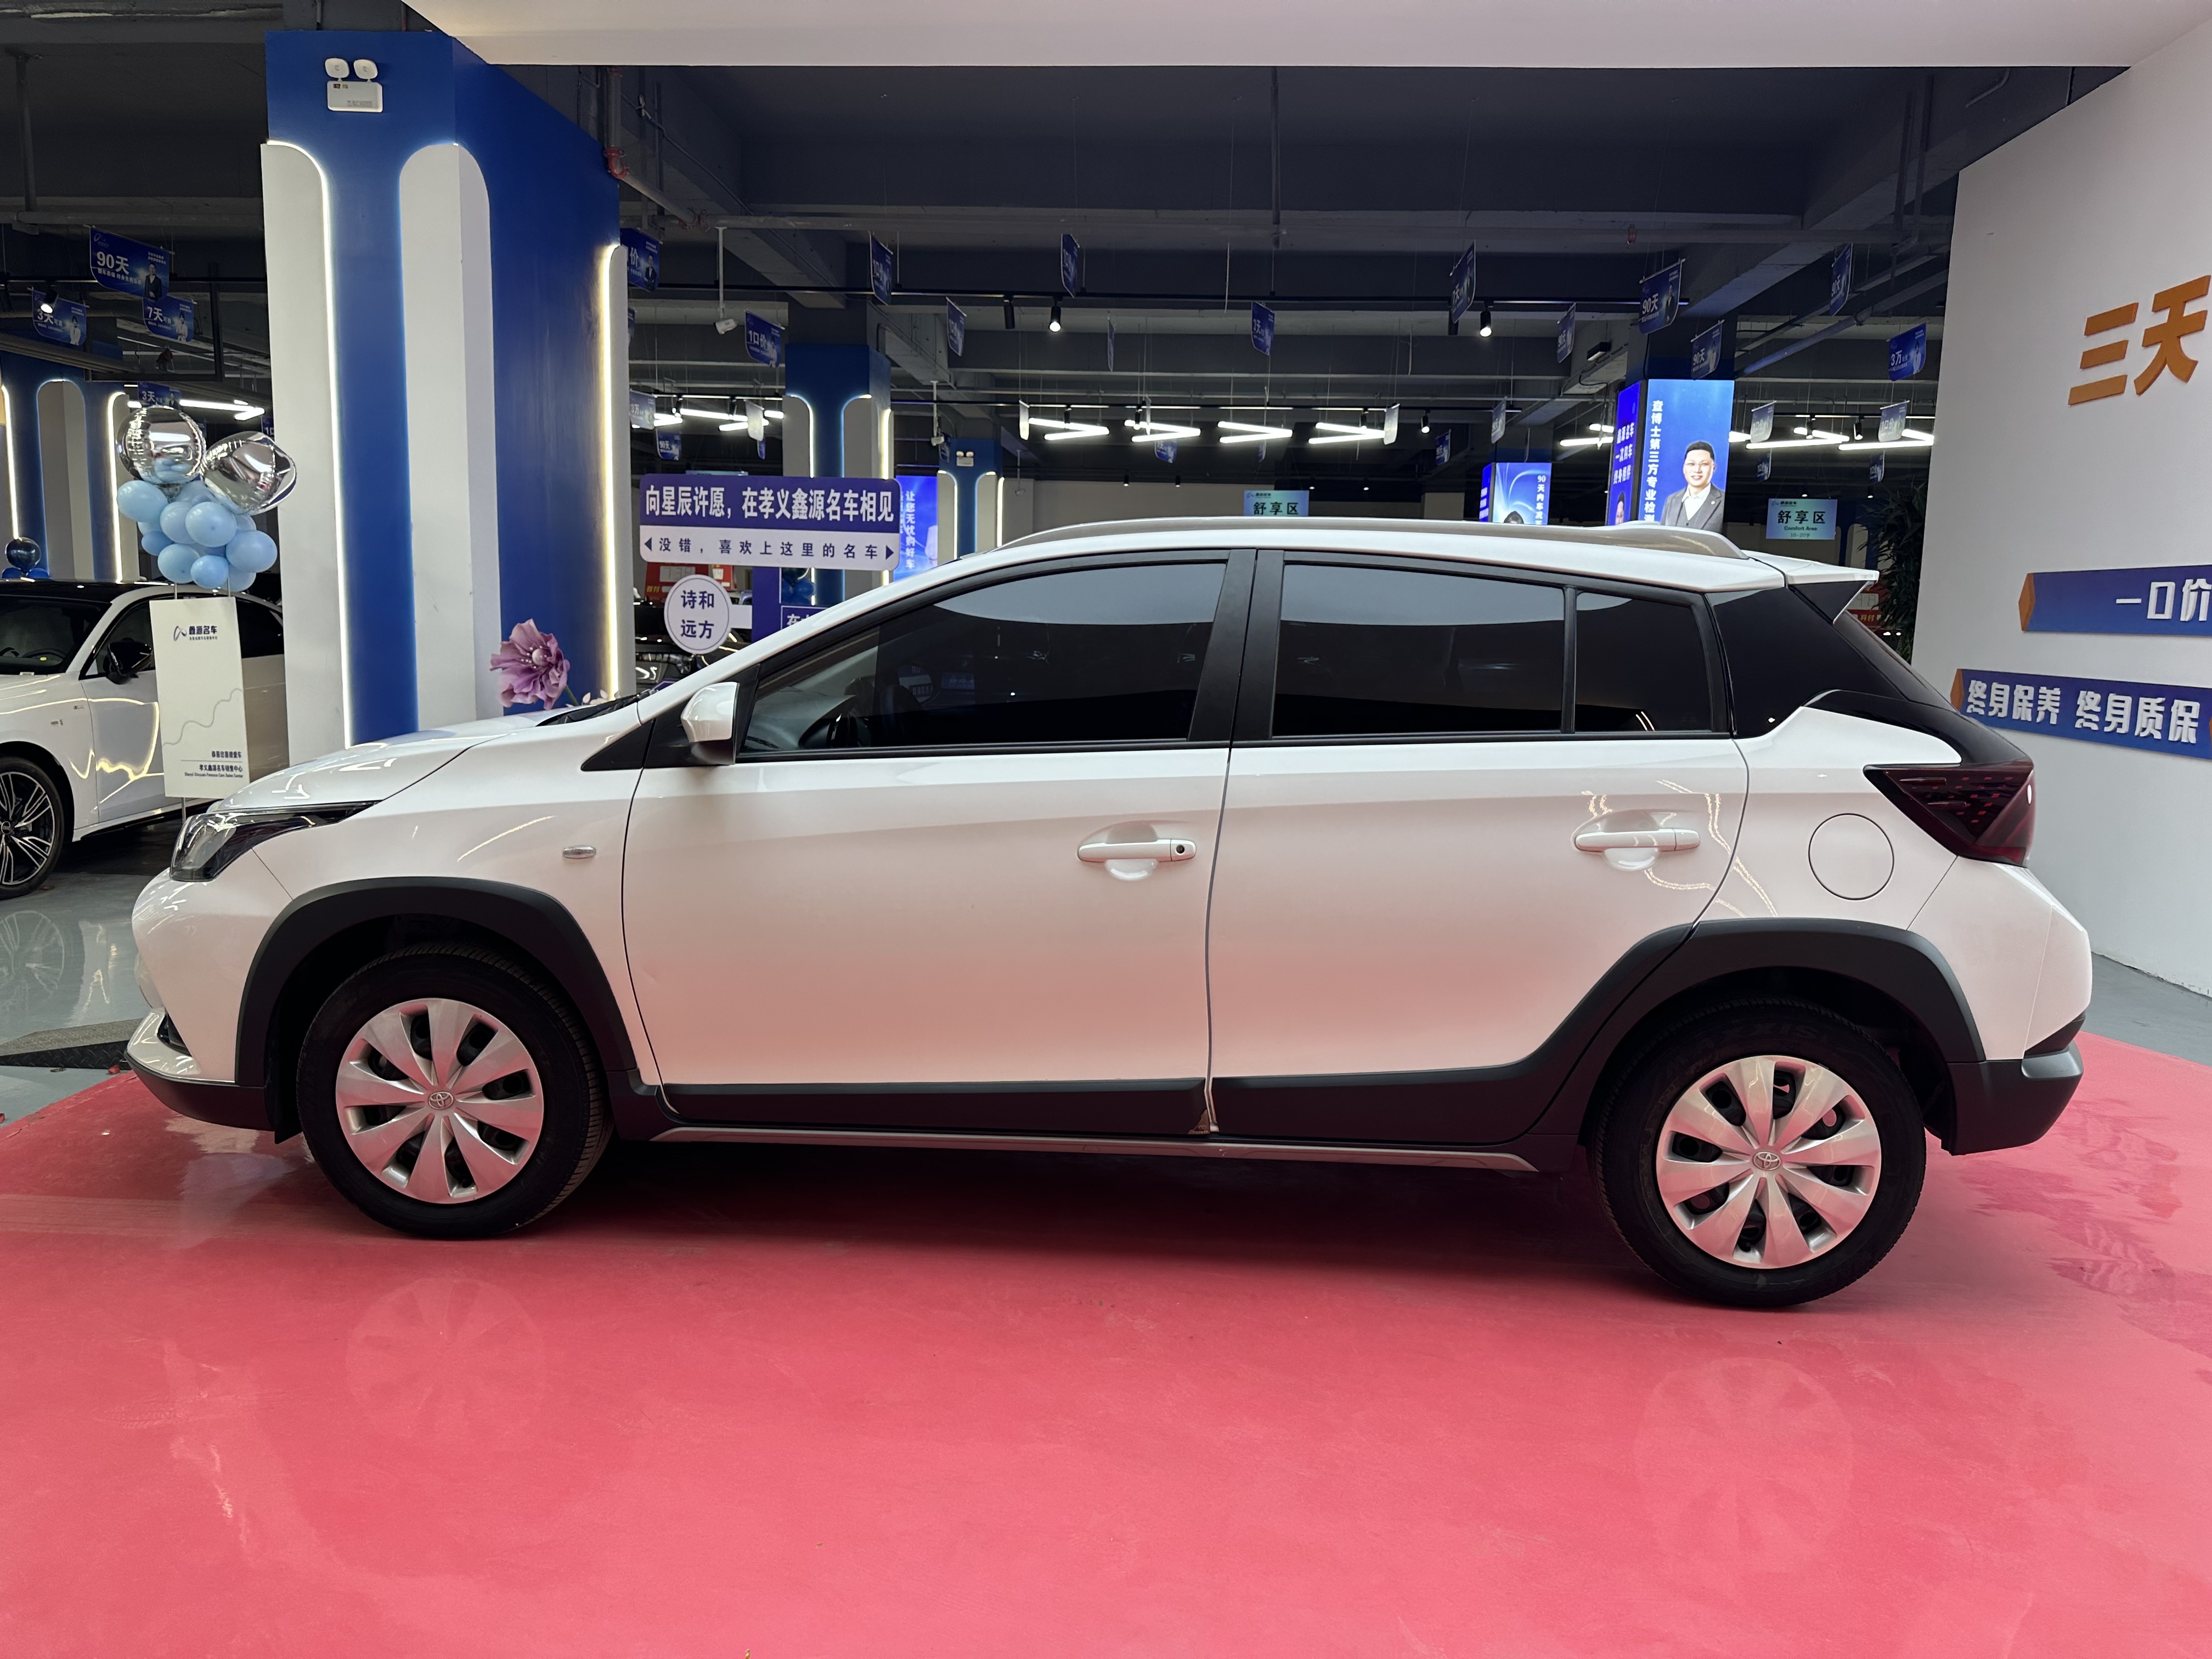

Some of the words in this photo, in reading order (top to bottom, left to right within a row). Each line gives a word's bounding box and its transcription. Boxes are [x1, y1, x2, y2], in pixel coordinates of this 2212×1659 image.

[97, 251, 129, 275] 90天
[1642, 293, 1659, 315] 90天
[2068, 275, 2211, 406] 三天
[1693, 348, 1705, 366] 90天
[1254, 501, 1299, 515] 舒享区
[1778, 510, 1825, 524] 舒享区
[681, 590, 714, 610] 诗和
[2116, 578, 2212, 622] 一口价
[680, 619, 714, 639] 远方
[1967, 680, 2061, 725] 终身保养
[2075, 690, 2200, 744] 终身质保
